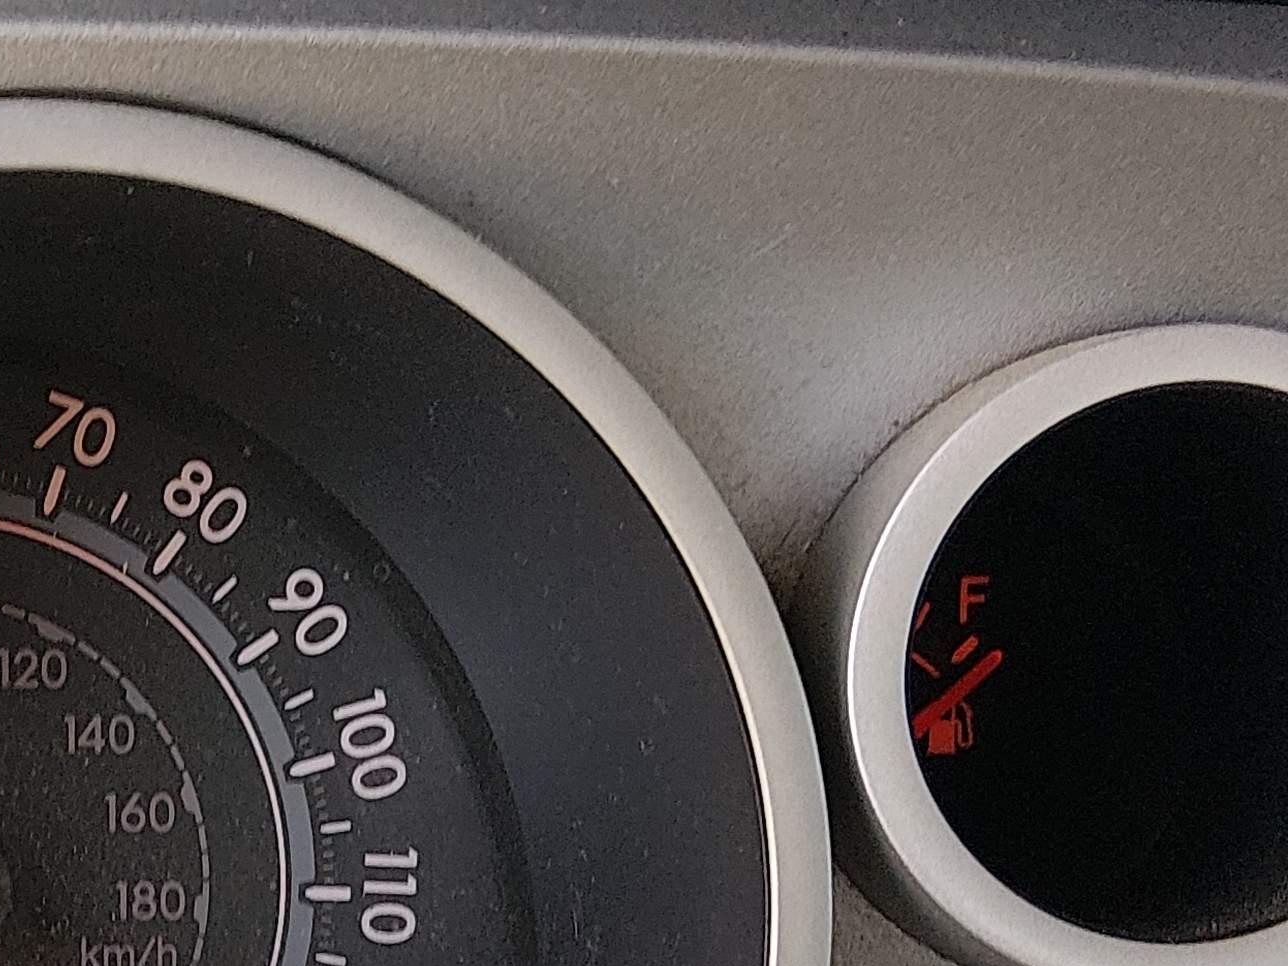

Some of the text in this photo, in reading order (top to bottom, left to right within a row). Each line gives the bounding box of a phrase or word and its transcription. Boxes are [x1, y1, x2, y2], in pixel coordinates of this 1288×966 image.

[33, 389, 116, 467] 70
[163, 459, 248, 543] 80
[268, 567, 349, 657] 90
[959, 575, 991, 625] F
[64, 713, 135, 755] 140
[332, 687, 408, 800] 100
[105, 792, 176, 834] 160
[115, 879, 186, 922] 180
[360, 846, 420, 945] 110
